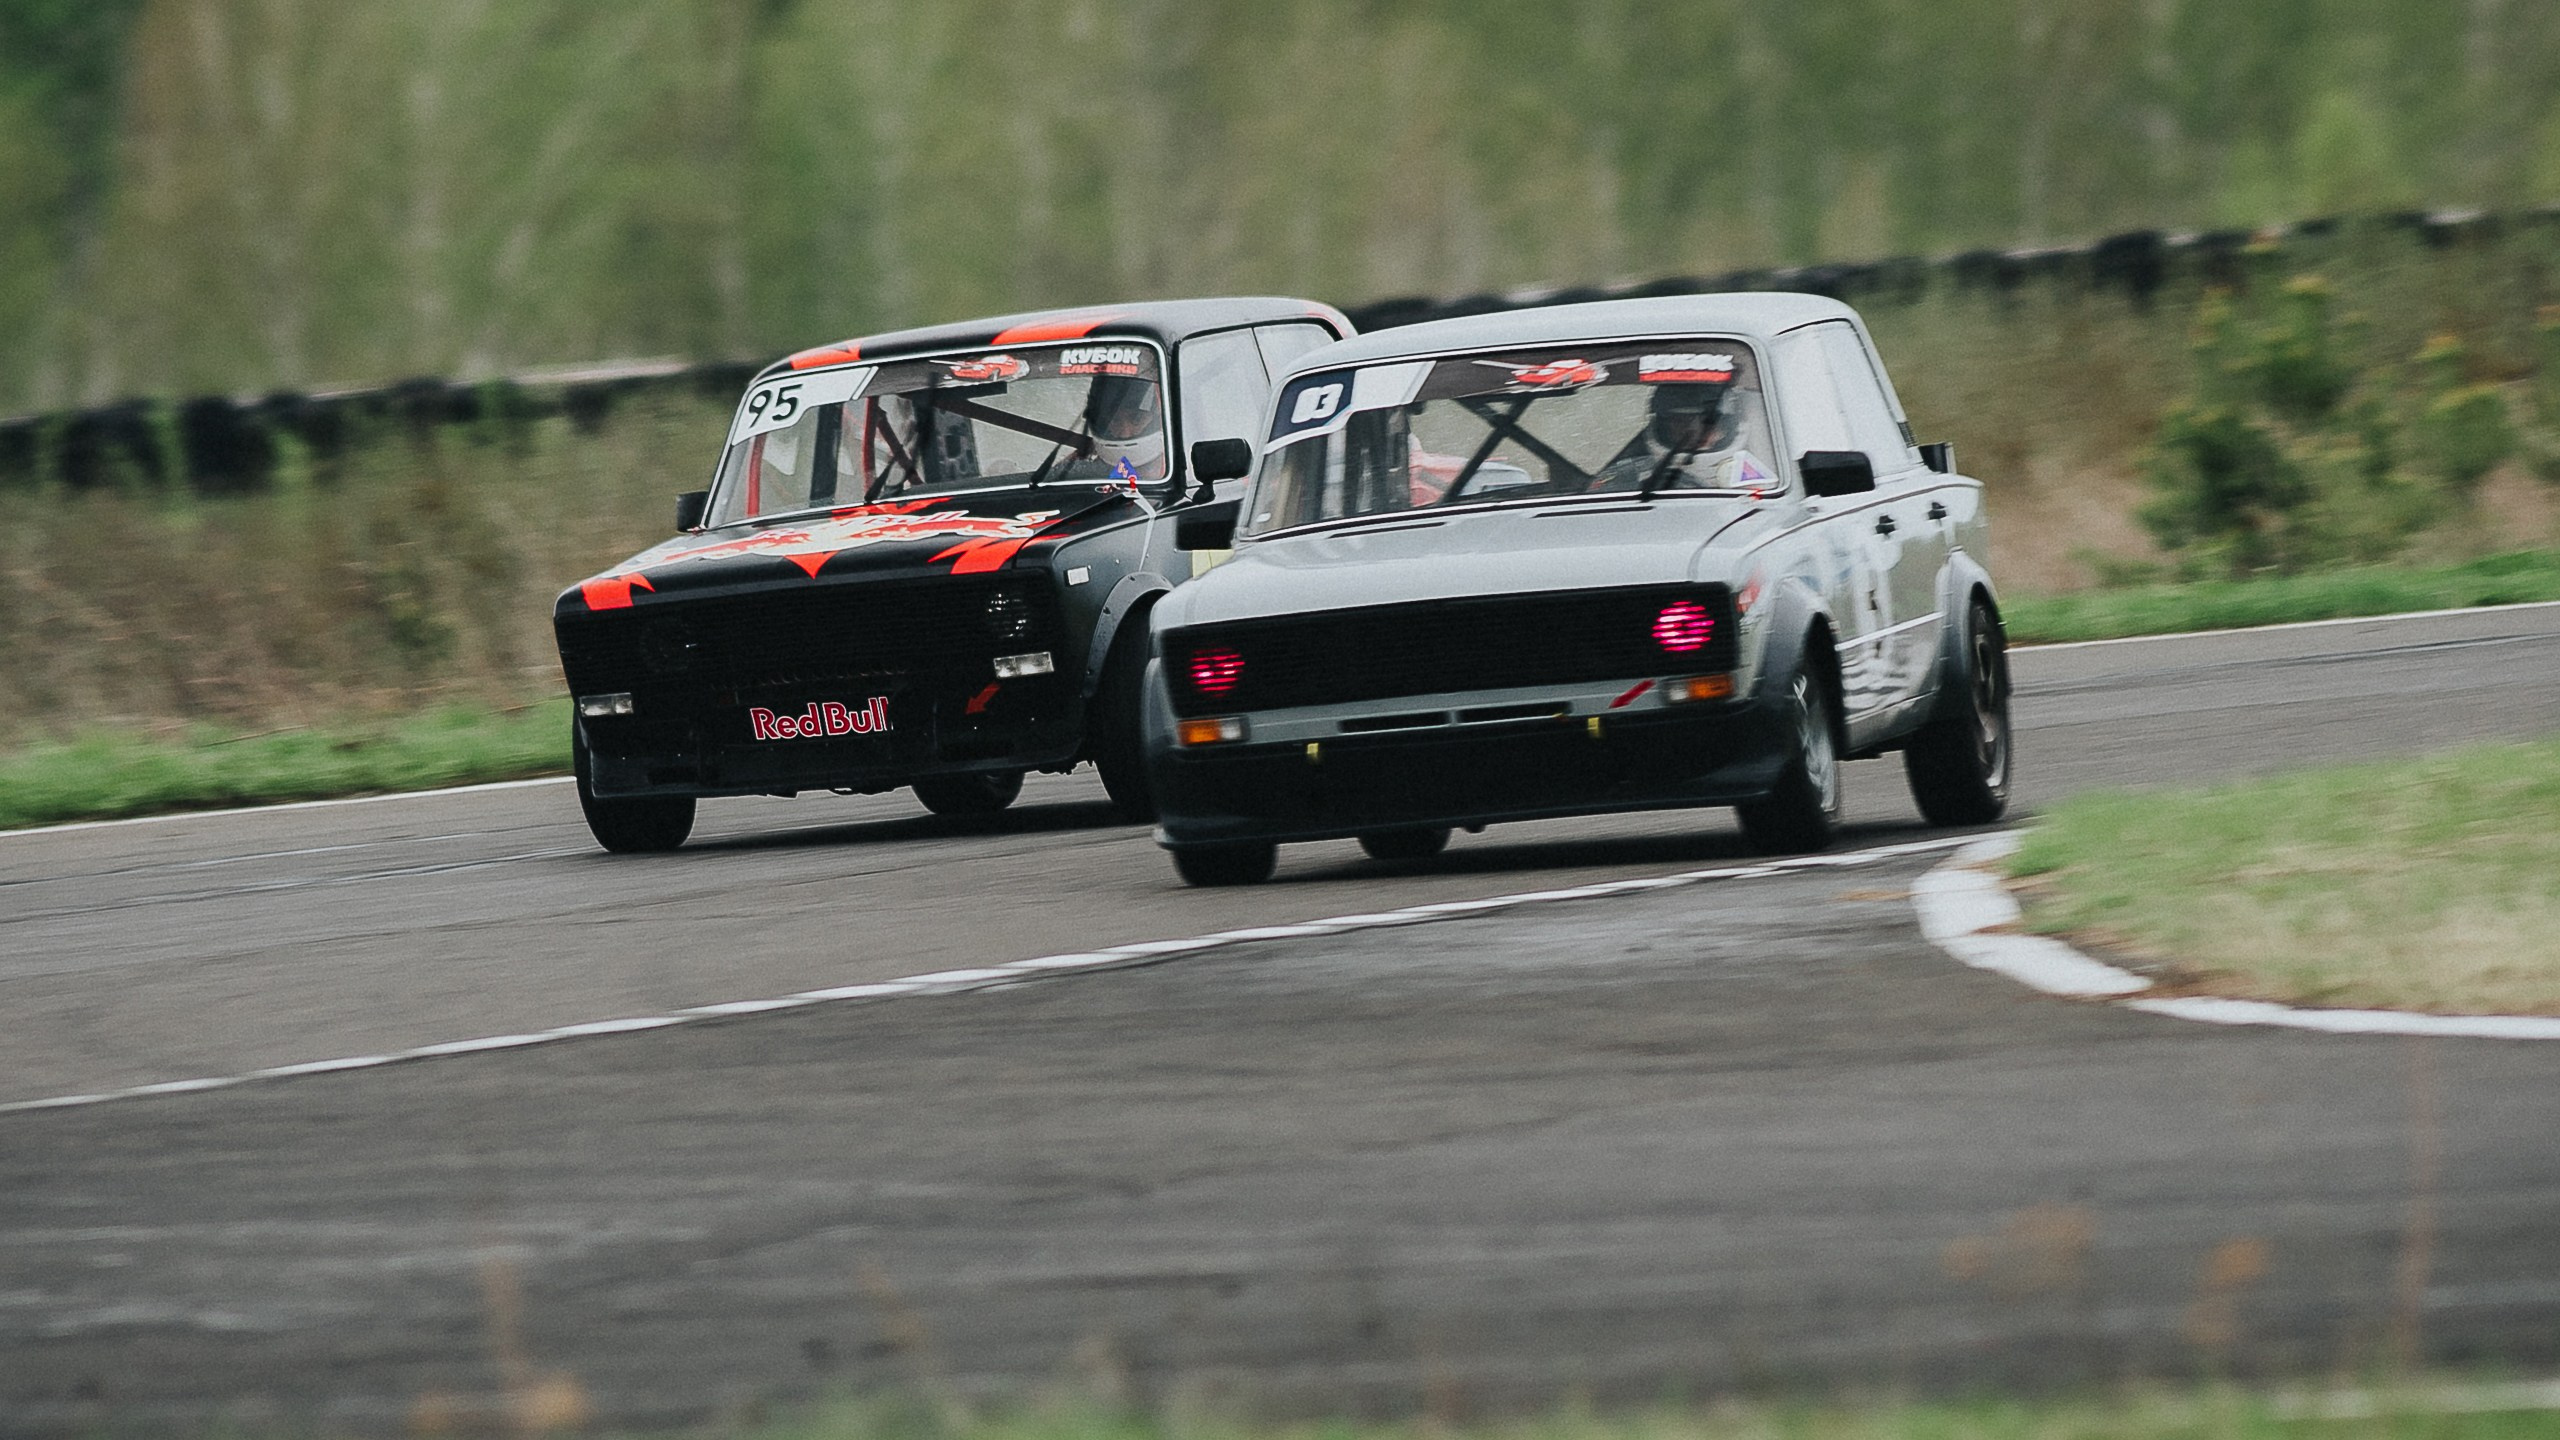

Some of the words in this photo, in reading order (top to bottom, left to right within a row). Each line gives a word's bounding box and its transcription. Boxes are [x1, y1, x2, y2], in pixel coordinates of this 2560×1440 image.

[1060, 347, 1140, 364] КУБОК
[748, 383, 803, 428] 95
[750, 702, 823, 740] Red
[822, 697, 889, 736] Bull
